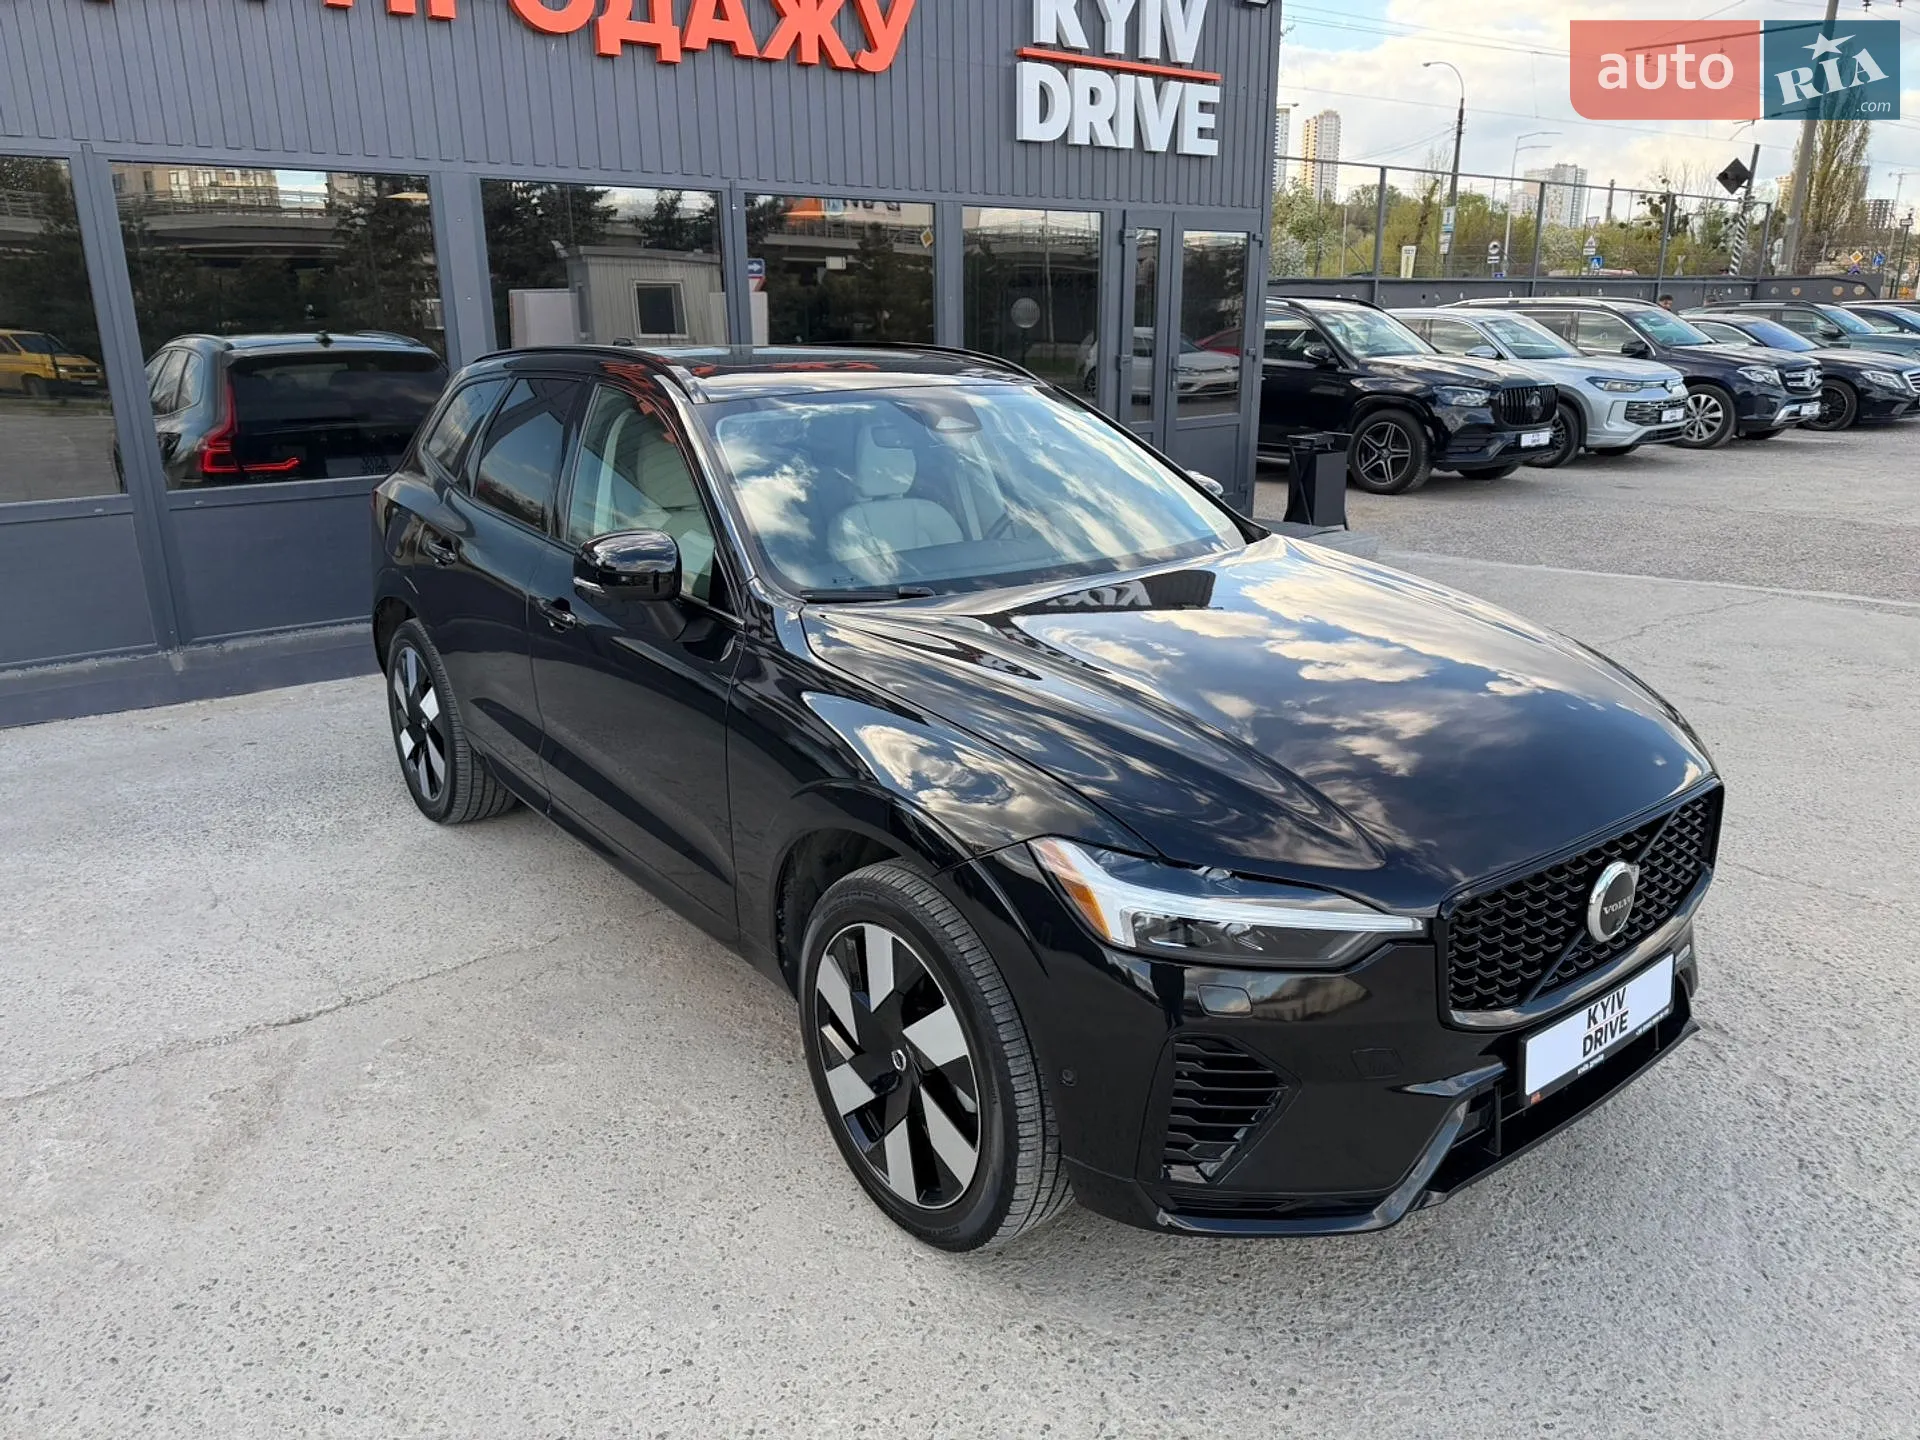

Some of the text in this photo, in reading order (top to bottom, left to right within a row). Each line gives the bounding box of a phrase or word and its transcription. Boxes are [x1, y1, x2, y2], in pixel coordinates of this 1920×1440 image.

[325, 0, 918, 72] ДАЖУ
[1033, 0, 1208, 64] KYIV
[1016, 61, 1220, 156] DRIVE
[1582, 1010, 1630, 1058] DRIVE
[1586, 987, 1627, 1029] KYIV
